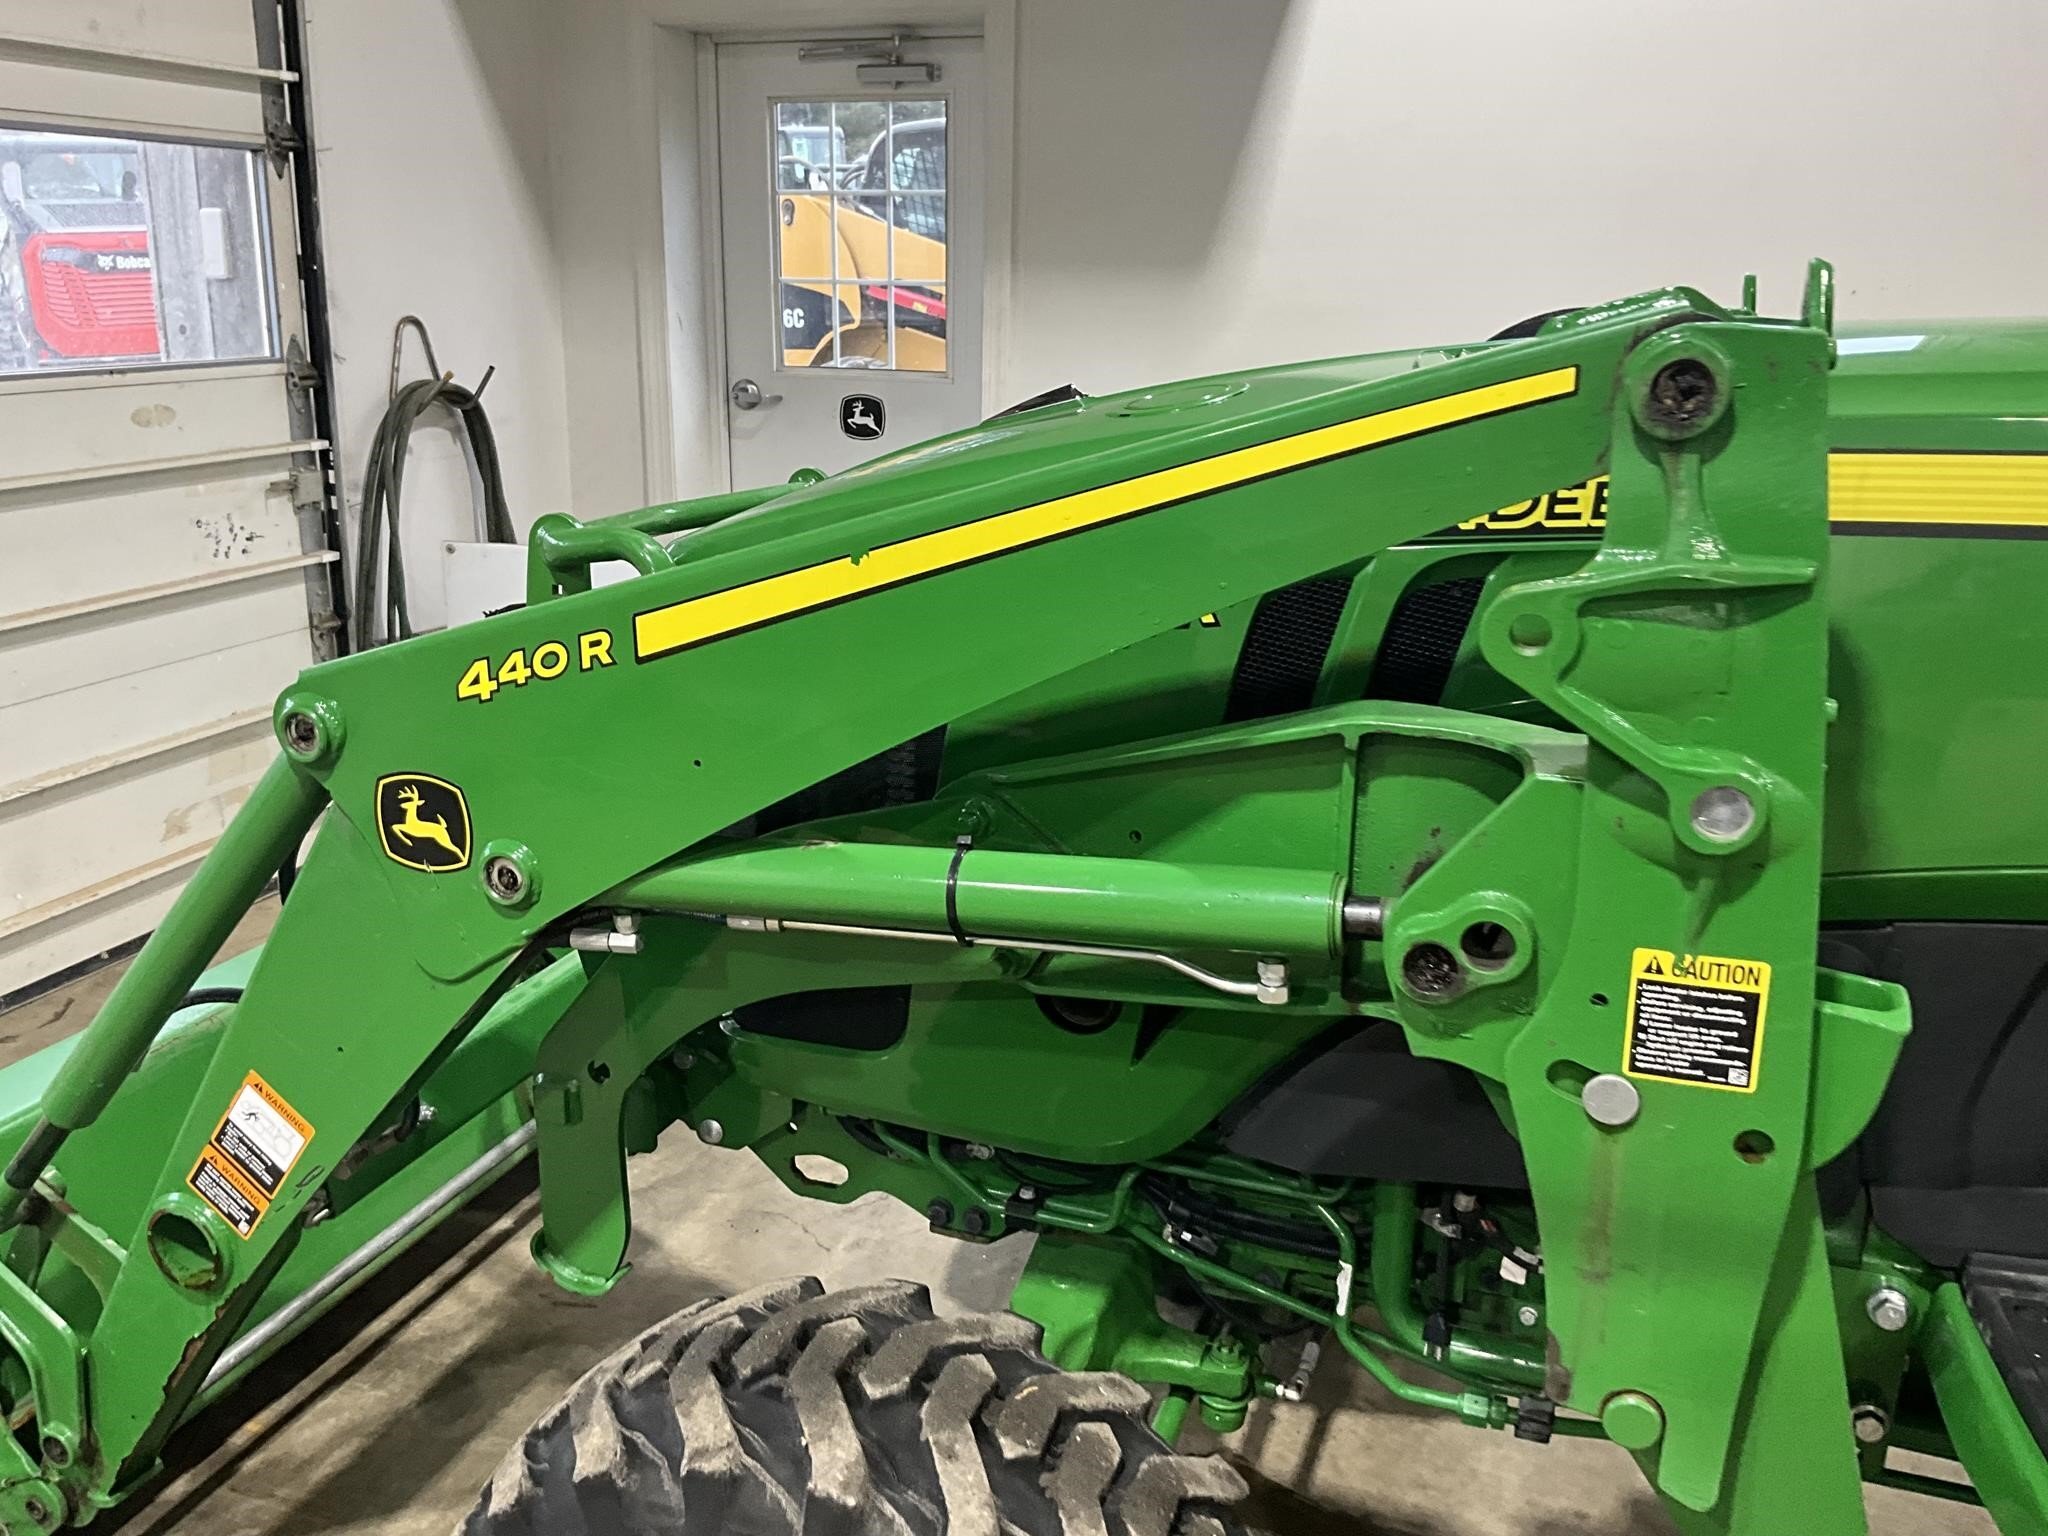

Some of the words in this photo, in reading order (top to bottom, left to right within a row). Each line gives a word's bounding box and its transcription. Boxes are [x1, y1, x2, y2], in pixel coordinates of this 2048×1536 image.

[782, 307, 805, 329] 6C
[263, 1088, 305, 1131] WARNING
[221, 1163, 261, 1206] WARNING
